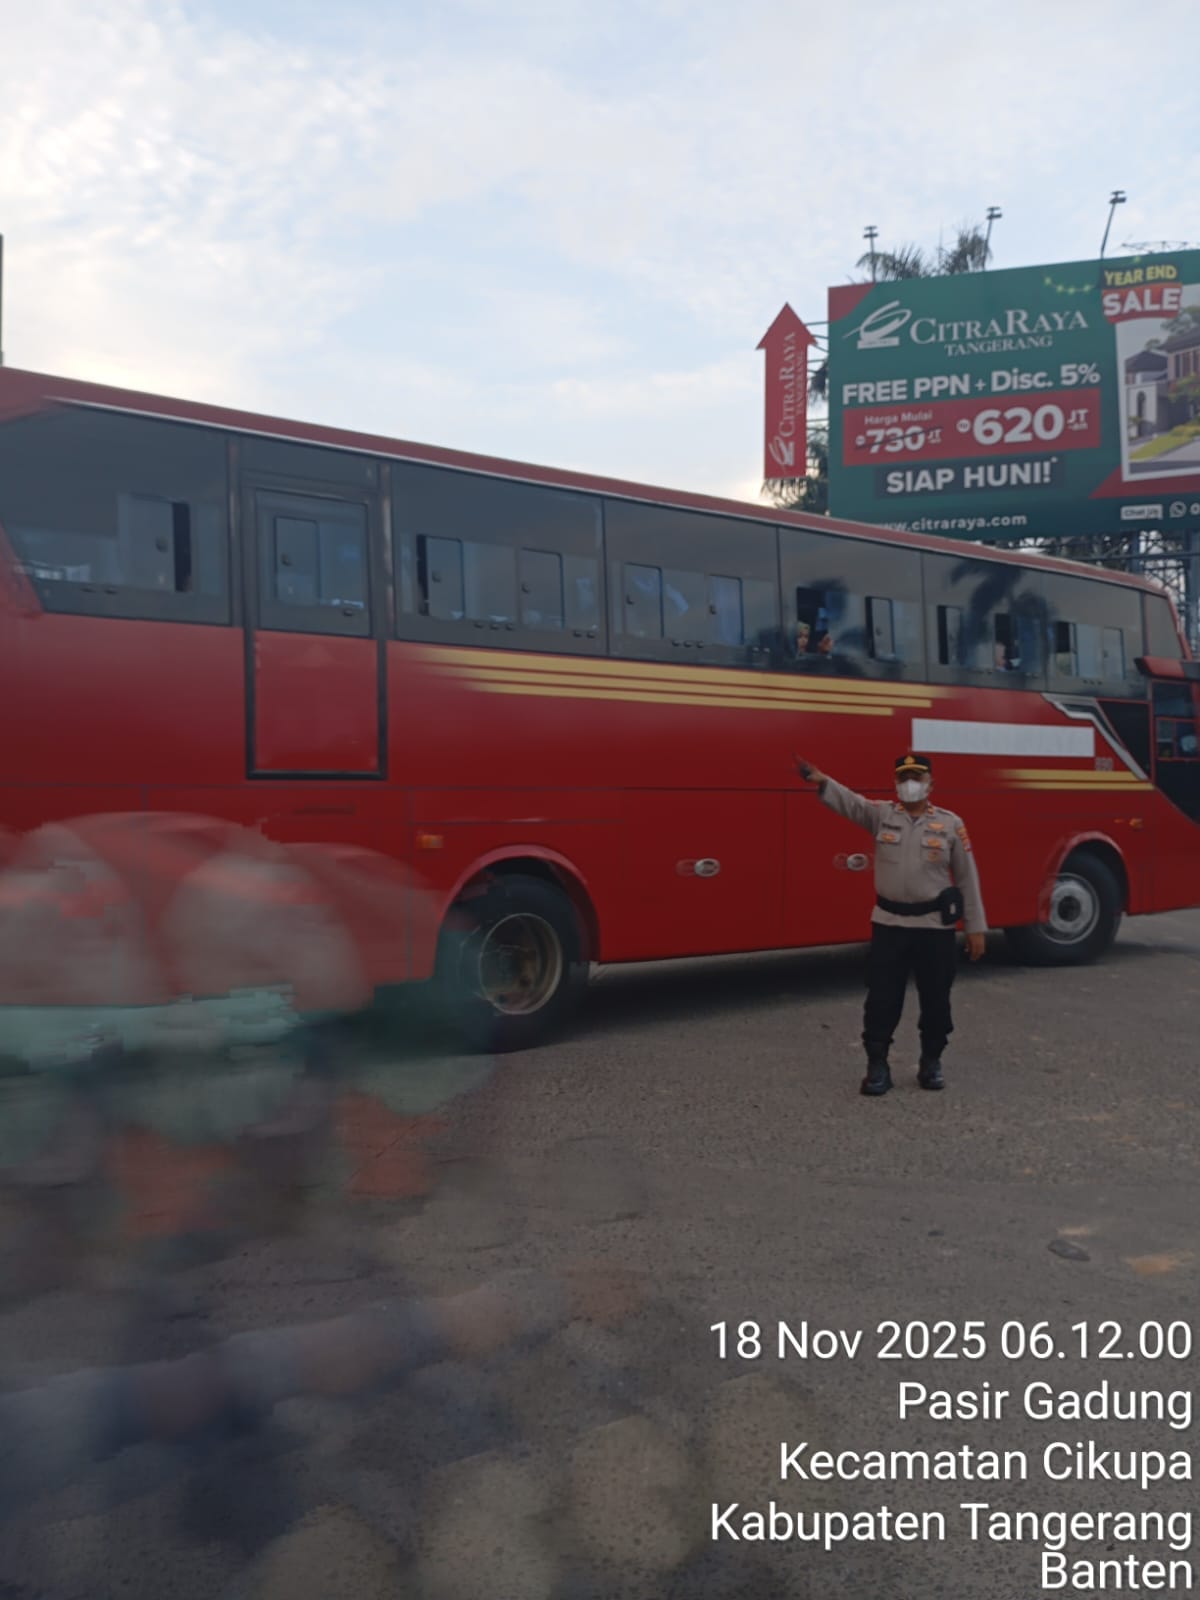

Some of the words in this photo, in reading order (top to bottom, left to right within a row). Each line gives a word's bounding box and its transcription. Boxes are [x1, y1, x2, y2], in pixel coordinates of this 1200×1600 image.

[1104, 267, 1144, 286] YEAR
[1145, 264, 1178, 282] END
[1102, 287, 1181, 316] SALE
[943, 335, 1053, 357] TANGERANG
[842, 378, 908, 404] FREE
[913, 373, 971, 400] PPN
[991, 367, 1054, 392] Disc.
[1060, 363, 1101, 386] 5%
[864, 414, 899, 426] Harga
[901, 409, 934, 424] Mulai
[973, 403, 1065, 446] 620
[1067, 408, 1089, 425] JT
[865, 425, 926, 454] 730
[886, 467, 955, 494] SIAP
